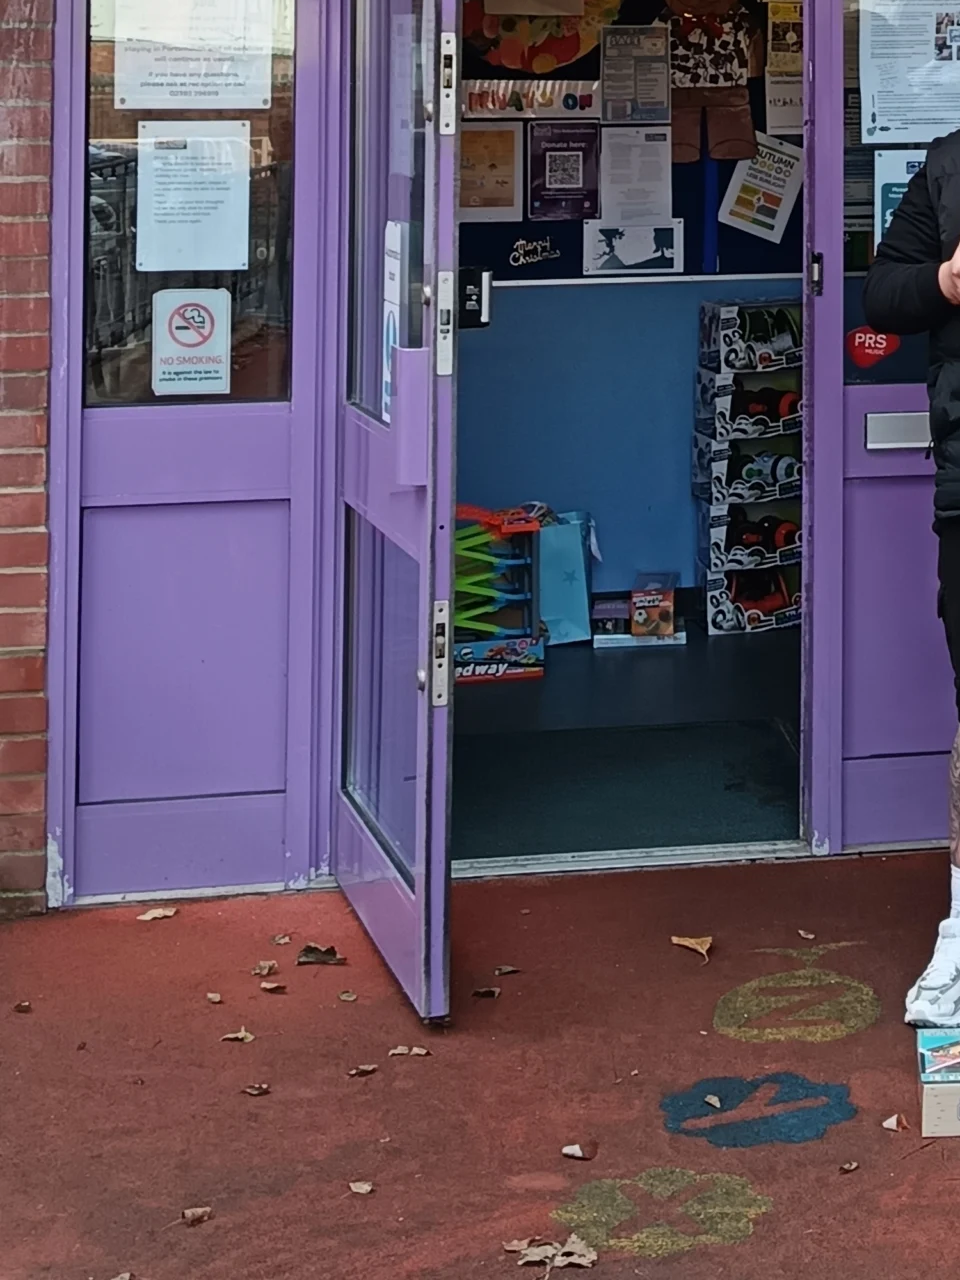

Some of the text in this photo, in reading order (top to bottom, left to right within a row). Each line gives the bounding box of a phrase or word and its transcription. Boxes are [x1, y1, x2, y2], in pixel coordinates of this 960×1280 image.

[540, 140, 568, 149] Donate
[854, 332, 887, 349] PRS
[159, 355, 174, 366] NO
